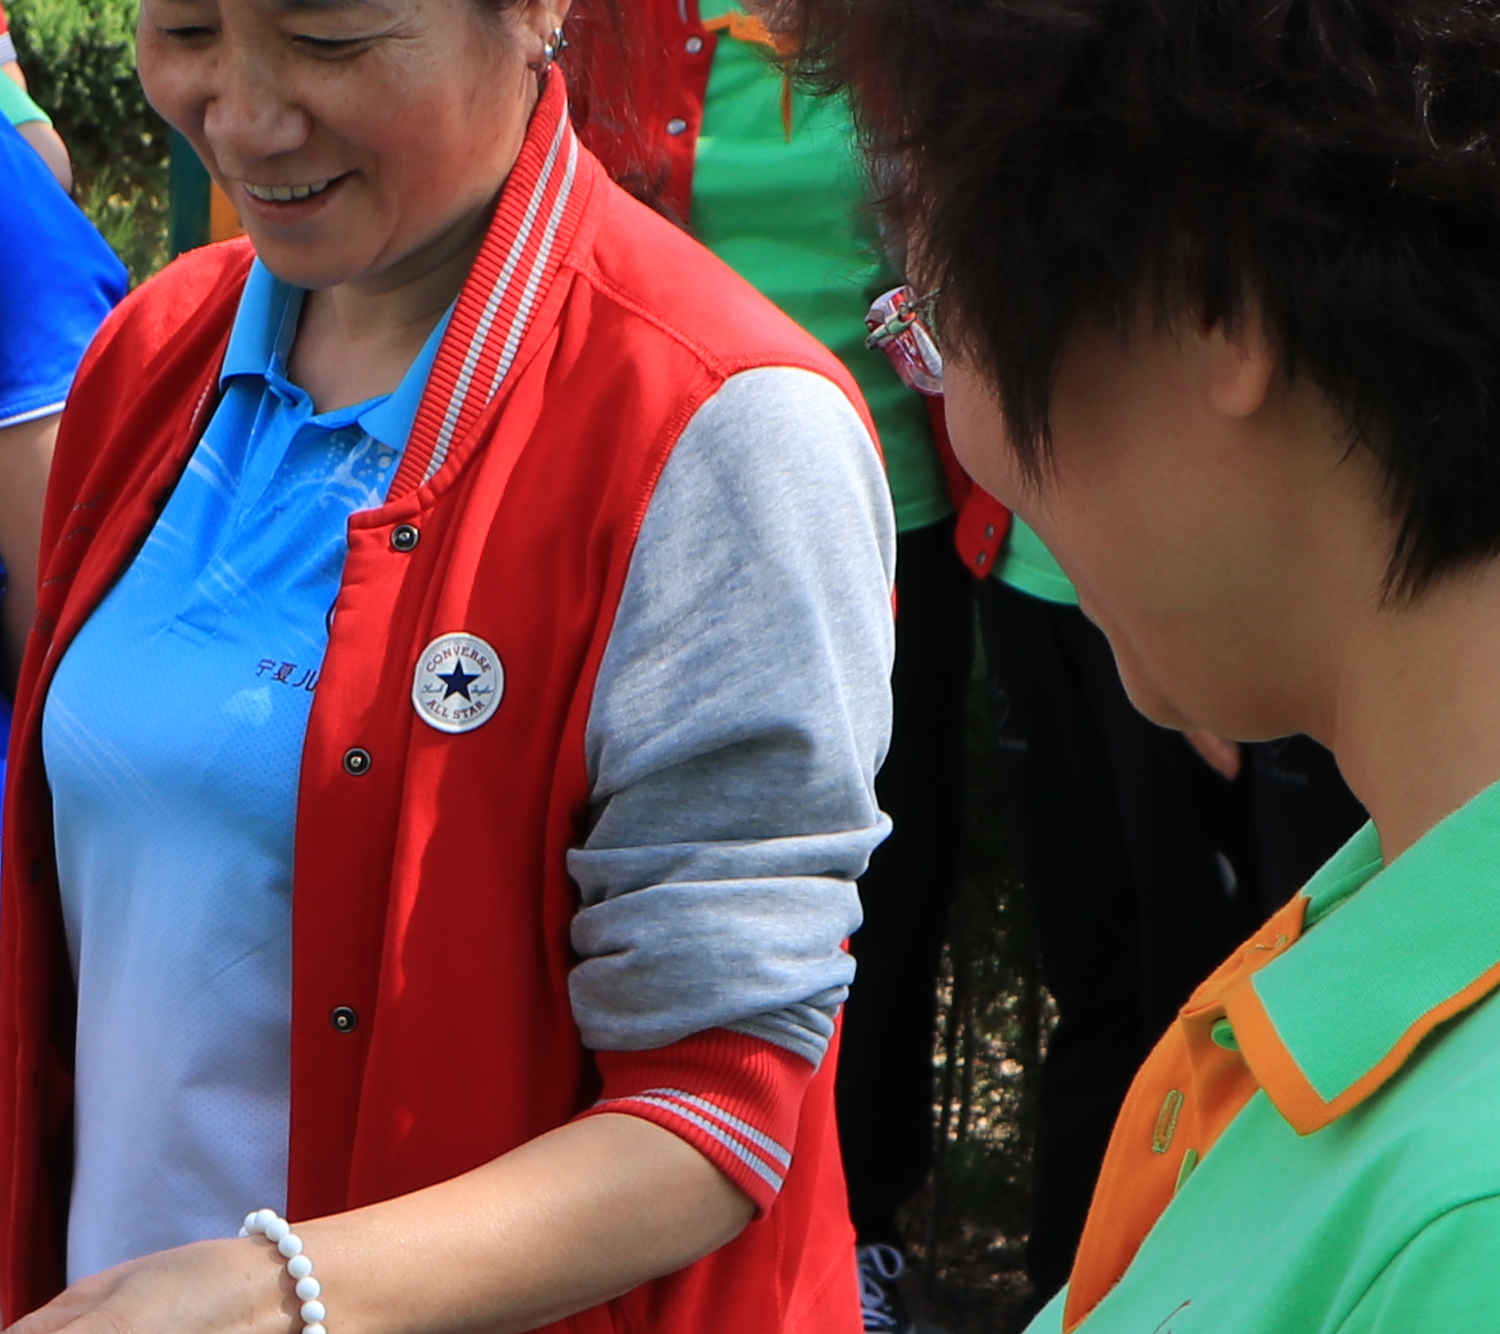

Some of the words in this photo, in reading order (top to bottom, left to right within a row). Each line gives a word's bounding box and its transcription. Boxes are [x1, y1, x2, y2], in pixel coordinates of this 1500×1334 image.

[426, 646, 492, 673] CONVERSE
[427, 699, 449, 719] ALL
[453, 700, 486, 720] STAR
